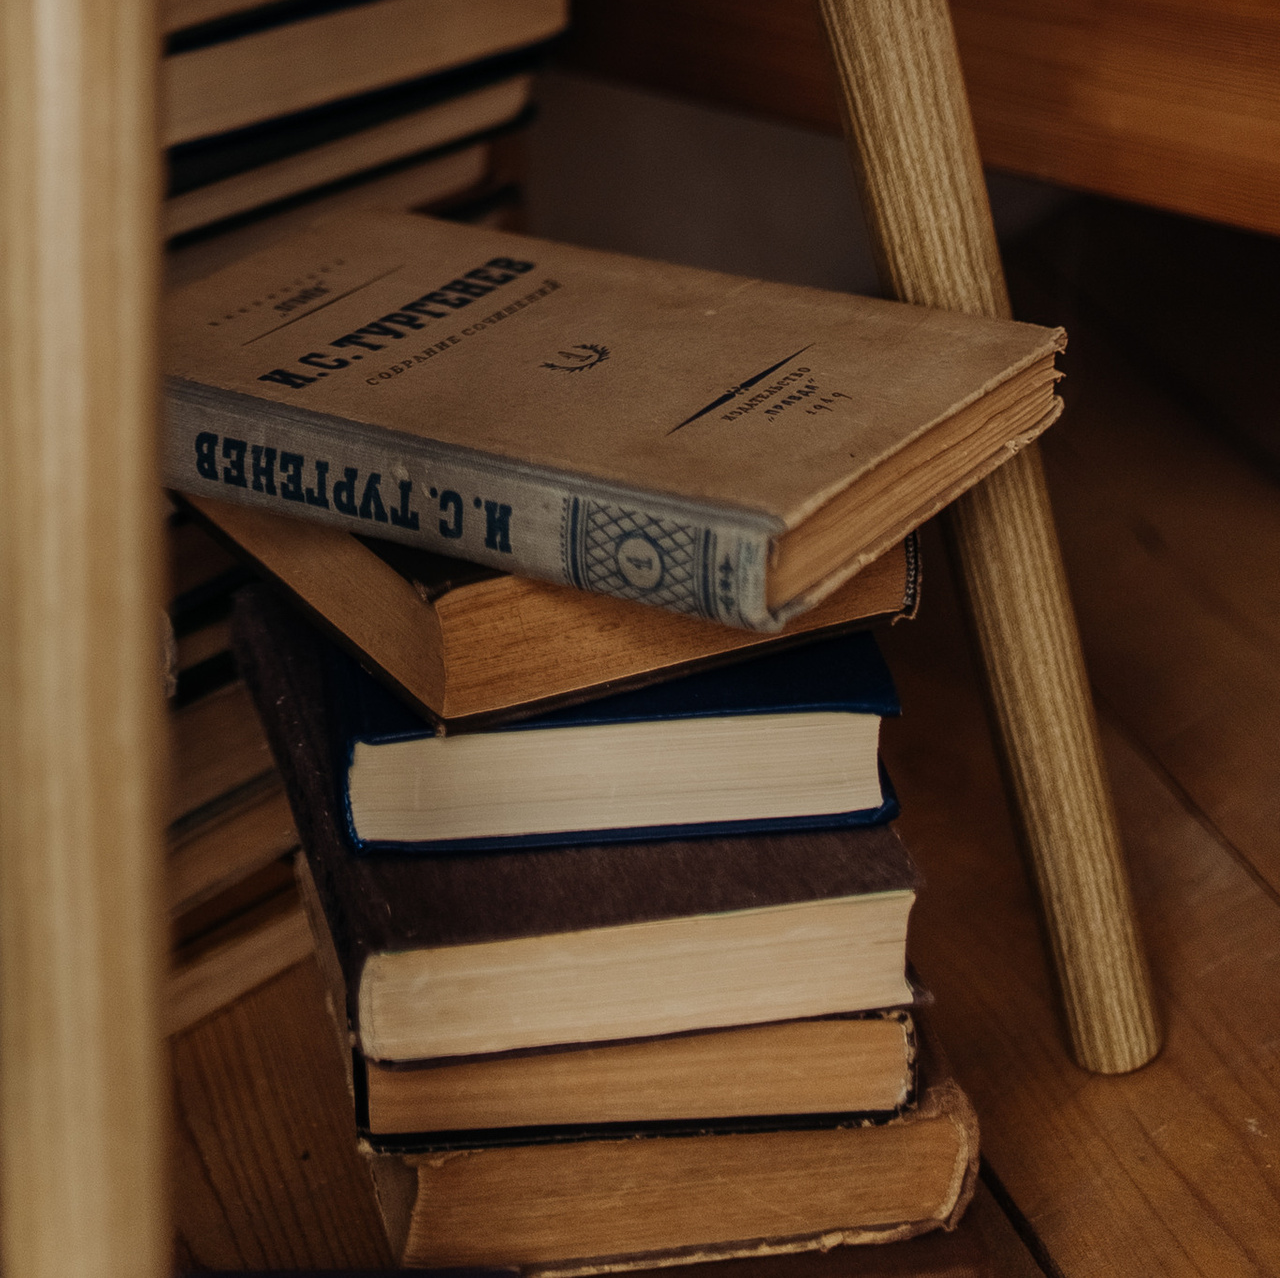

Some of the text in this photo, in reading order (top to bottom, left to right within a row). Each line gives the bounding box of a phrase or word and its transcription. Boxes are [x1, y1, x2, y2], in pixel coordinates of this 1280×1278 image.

[365, 278, 563, 387] СОБРАНИЕ СОЧИНЕНИЙ
[722, 366, 812, 422] ИЗДАТЕЛЬСТВО
